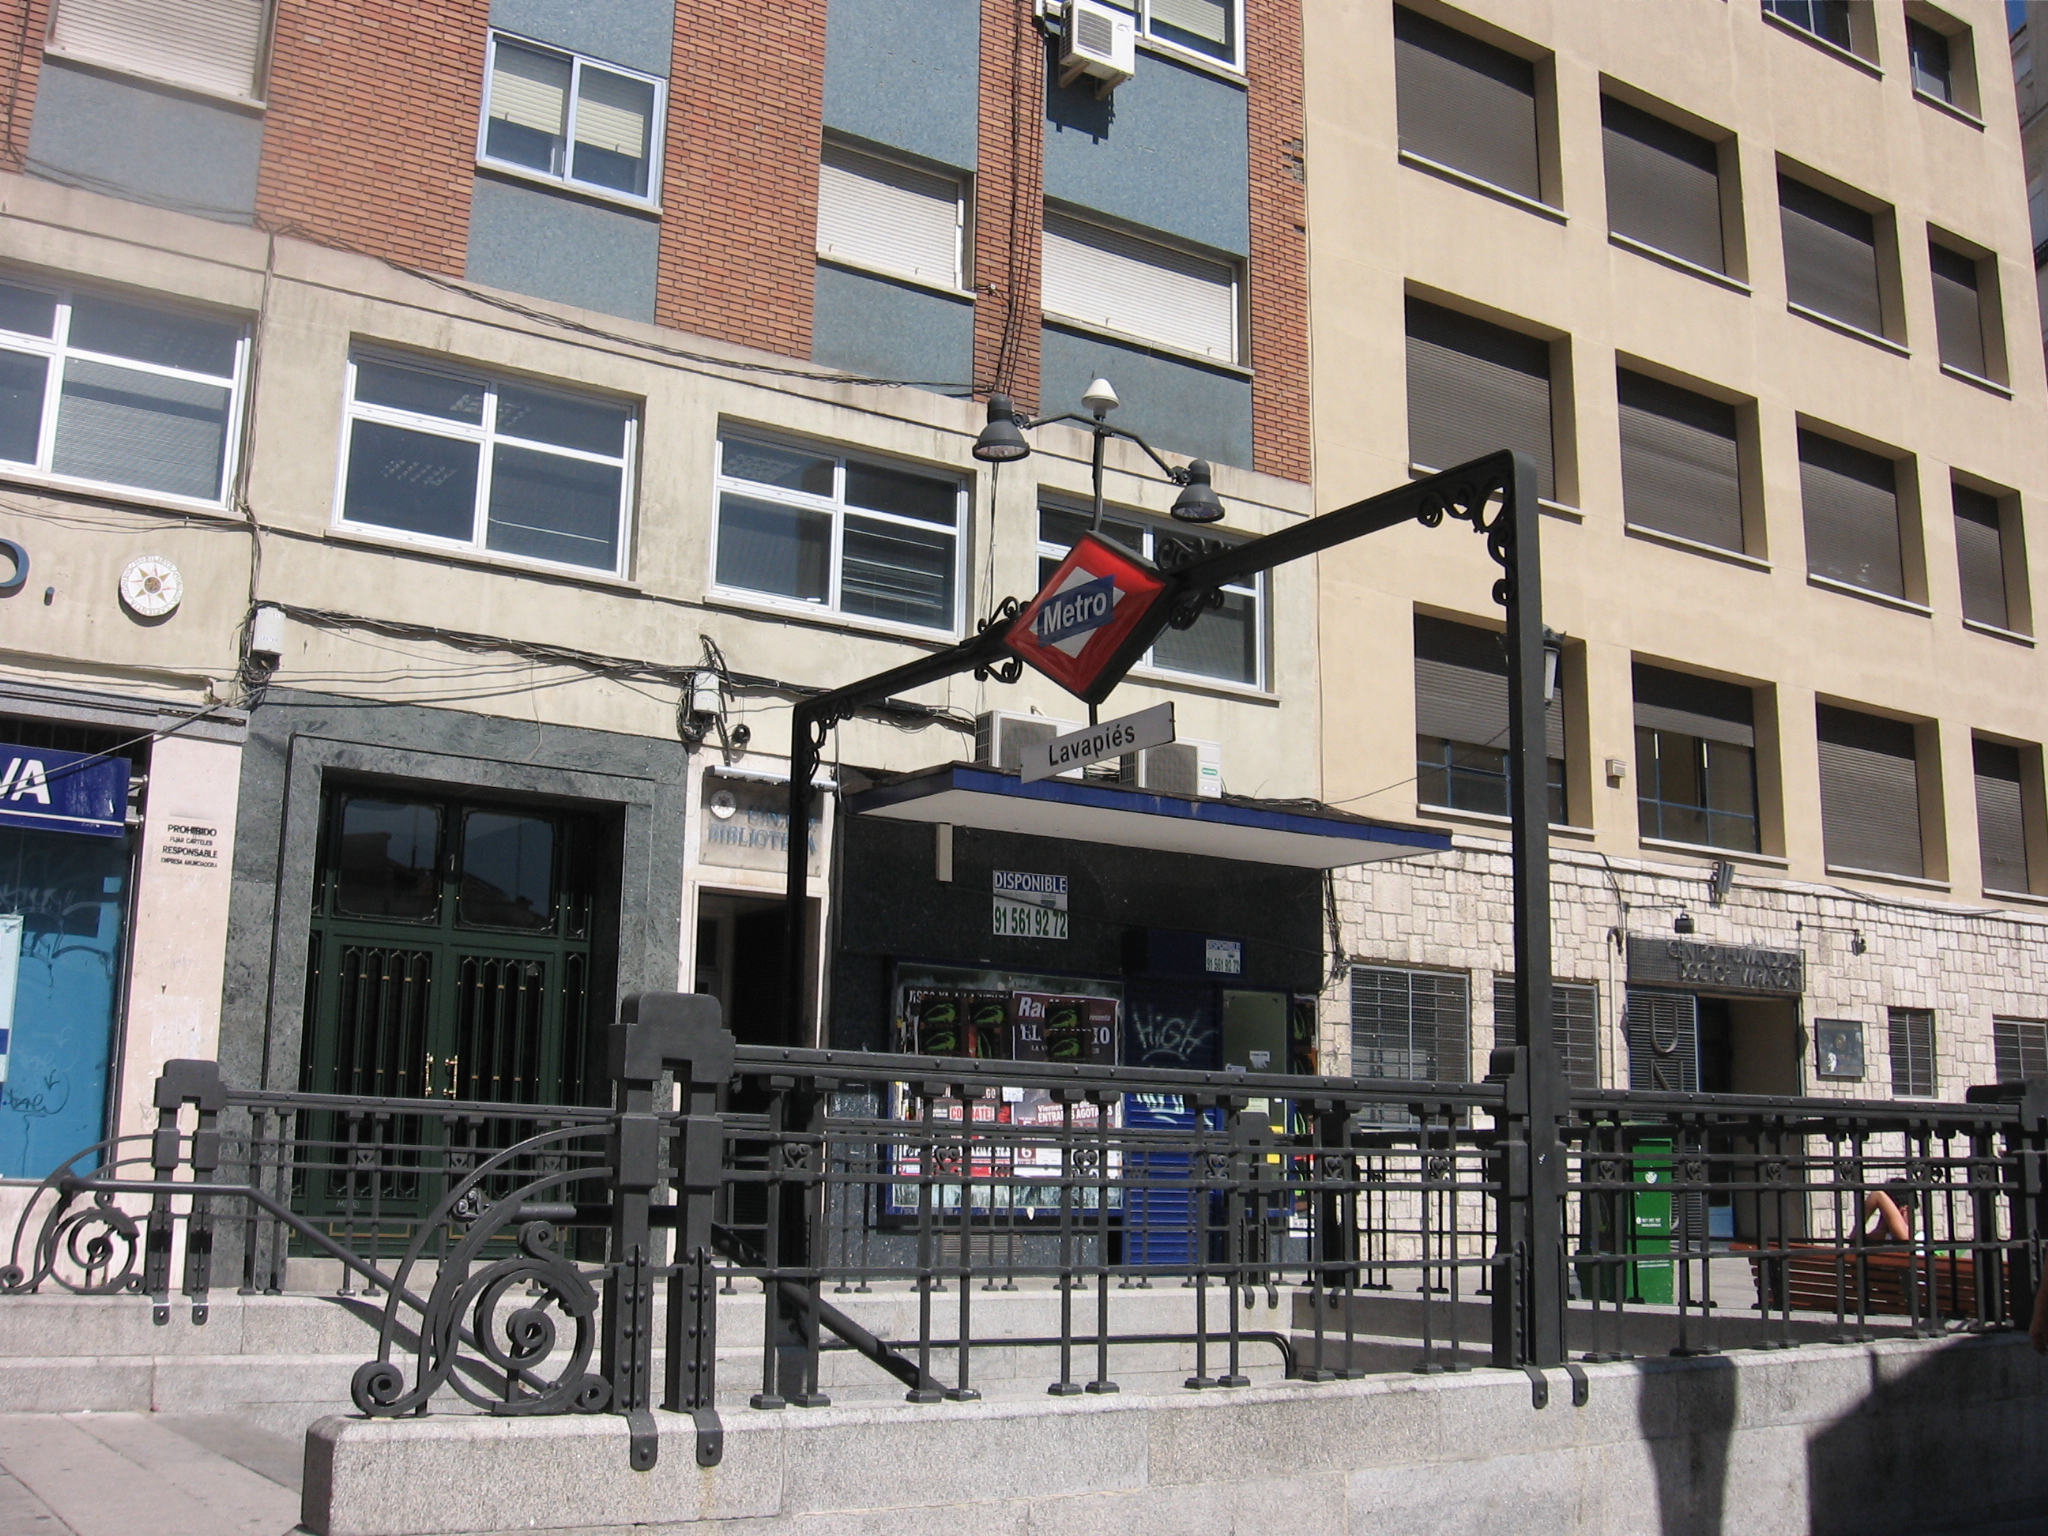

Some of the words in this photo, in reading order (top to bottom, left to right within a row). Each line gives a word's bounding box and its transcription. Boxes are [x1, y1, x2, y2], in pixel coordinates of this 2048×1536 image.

[1043, 592, 1107, 635] Metro
[1049, 724, 1135, 766] Lavapiés
[167, 824, 217, 837] PROHIBIDO
[708, 823, 817, 855] BIBLIOTEA
[162, 845, 218, 858] RESPONSABLE
[995, 872, 1067, 893] DISPONIBLE
[995, 906, 1007, 933] 91
[1012, 907, 1031, 935] 561
[1035, 909, 1049, 936] 92
[1053, 910, 1066, 937] 72
[1076, 1104, 1113, 1119] AGOTAS
